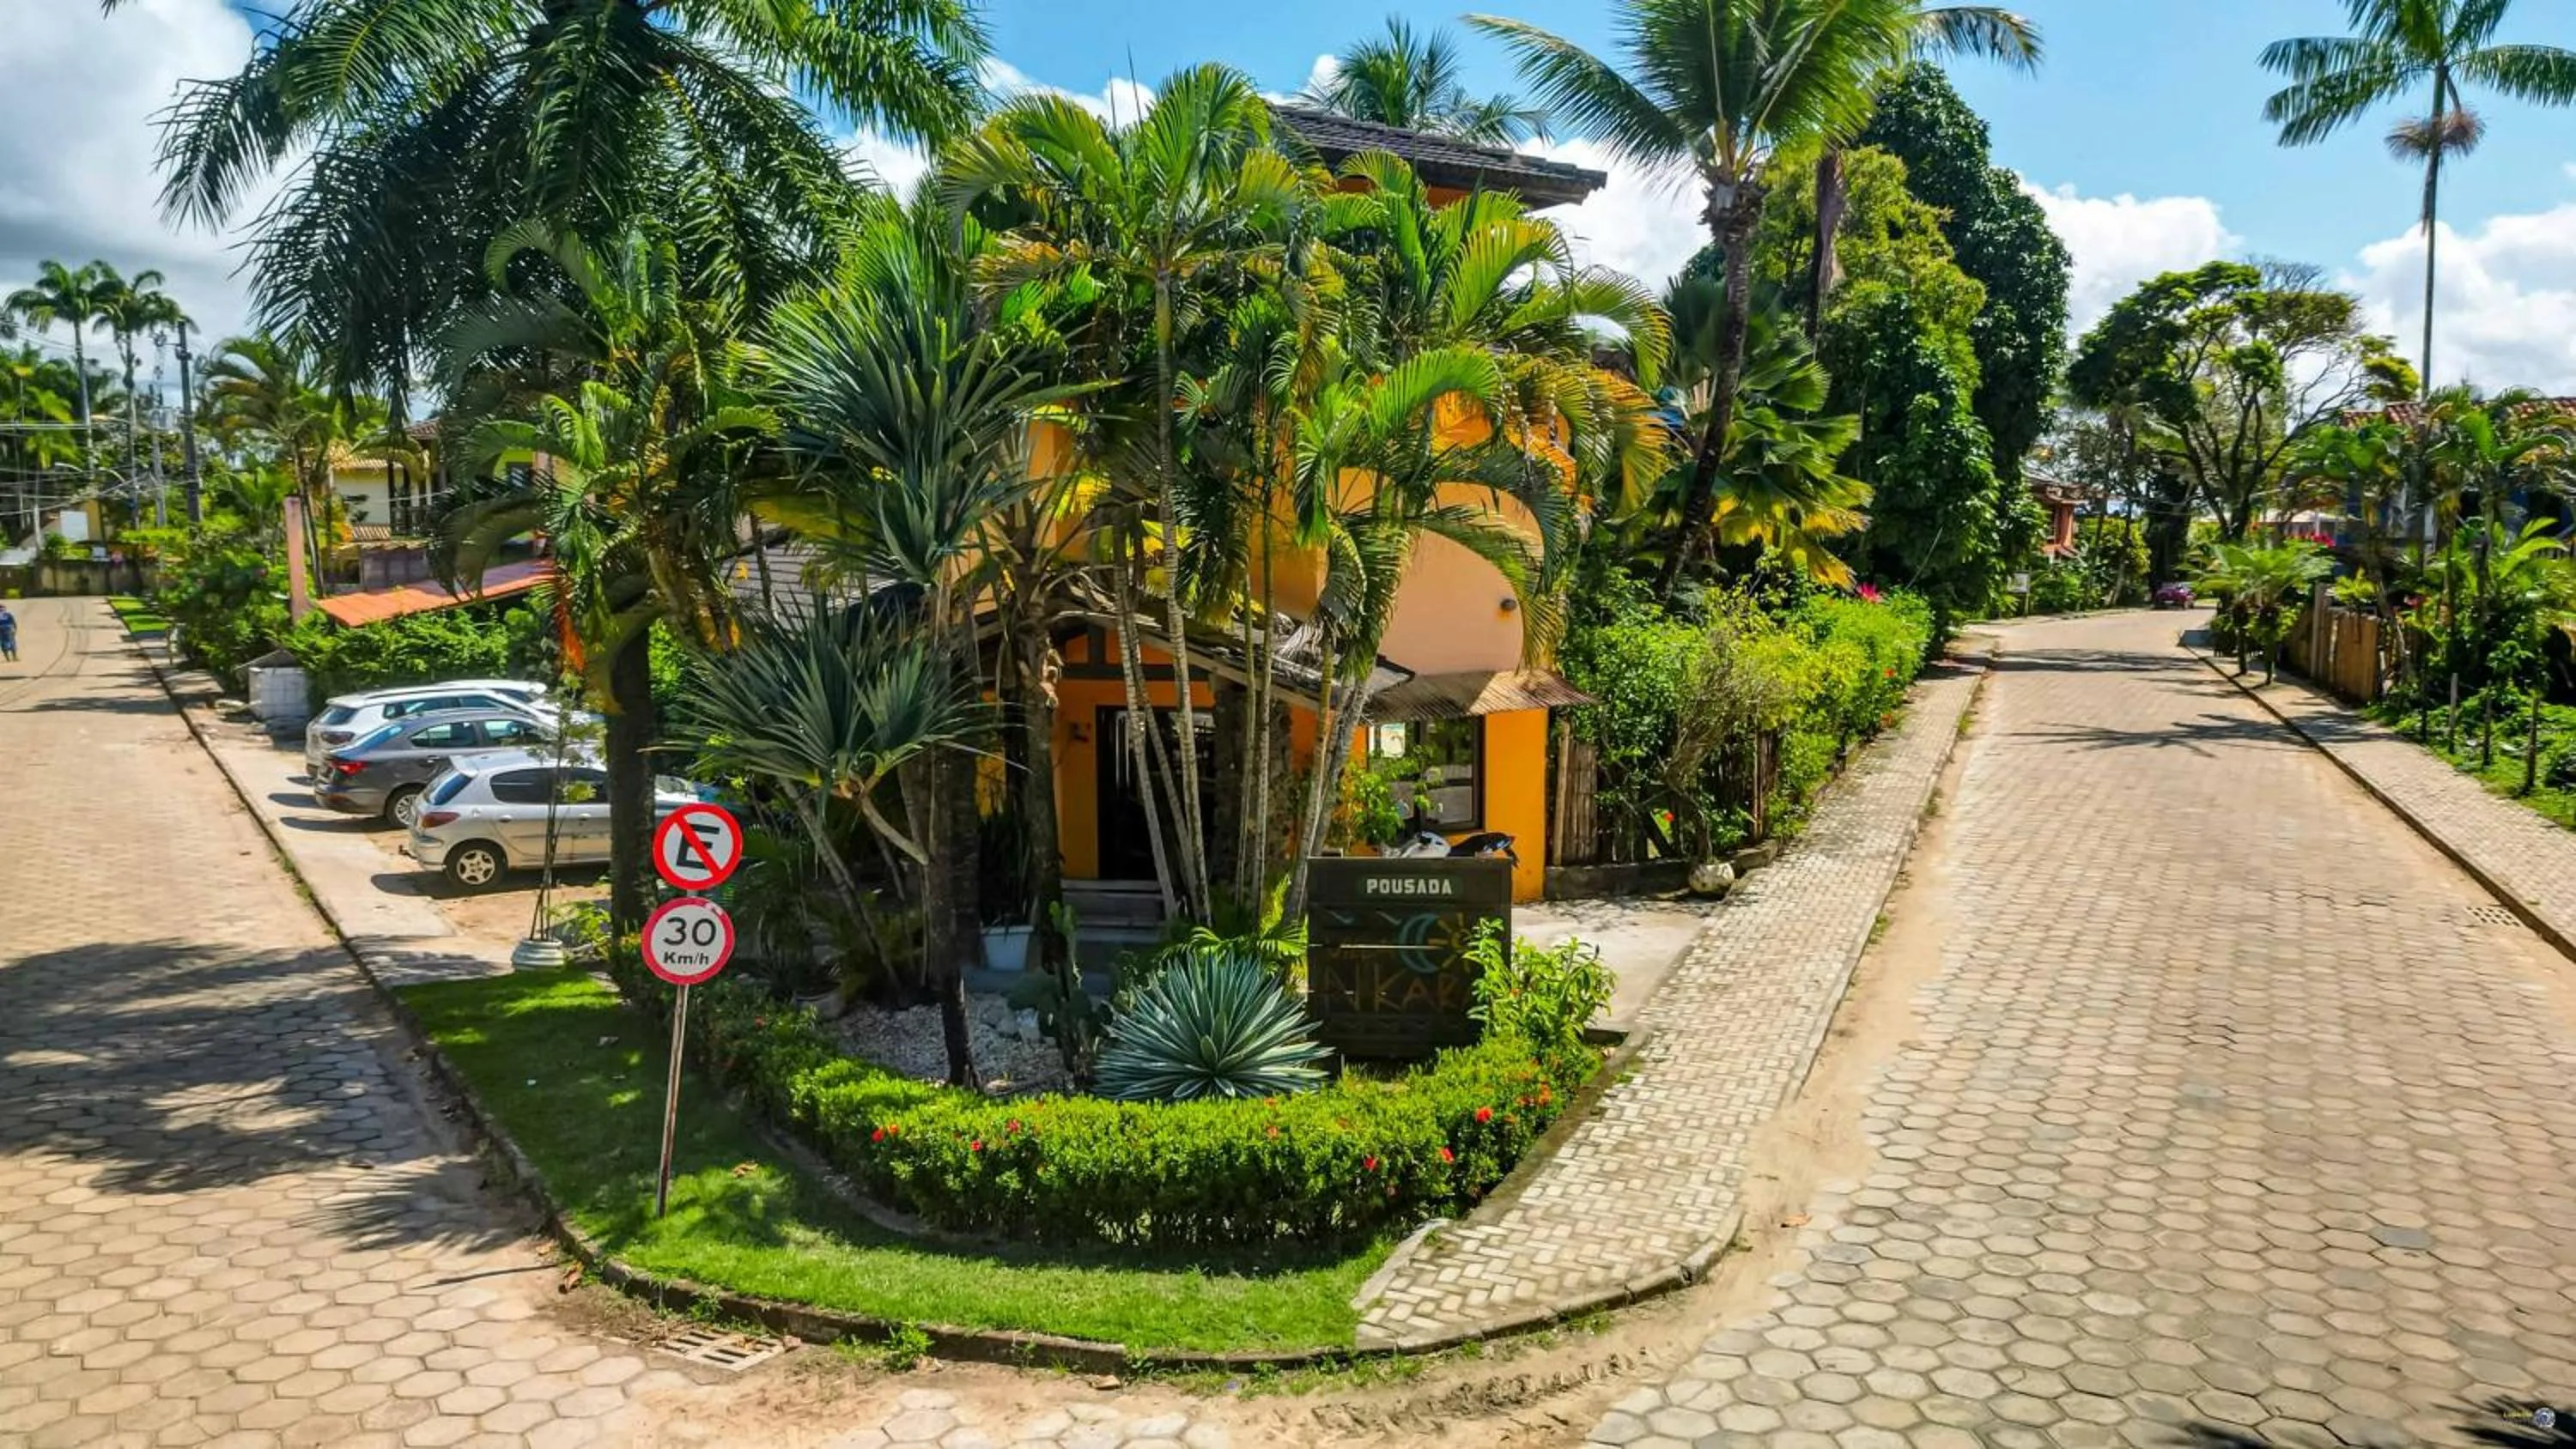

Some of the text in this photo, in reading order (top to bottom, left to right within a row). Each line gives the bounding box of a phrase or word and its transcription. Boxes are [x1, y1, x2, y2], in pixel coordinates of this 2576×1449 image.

[676, 823, 720, 870] E
[1366, 878, 1452, 894] POUSADA
[663, 917, 716, 946] 30
[663, 951, 709, 966] Km/h
